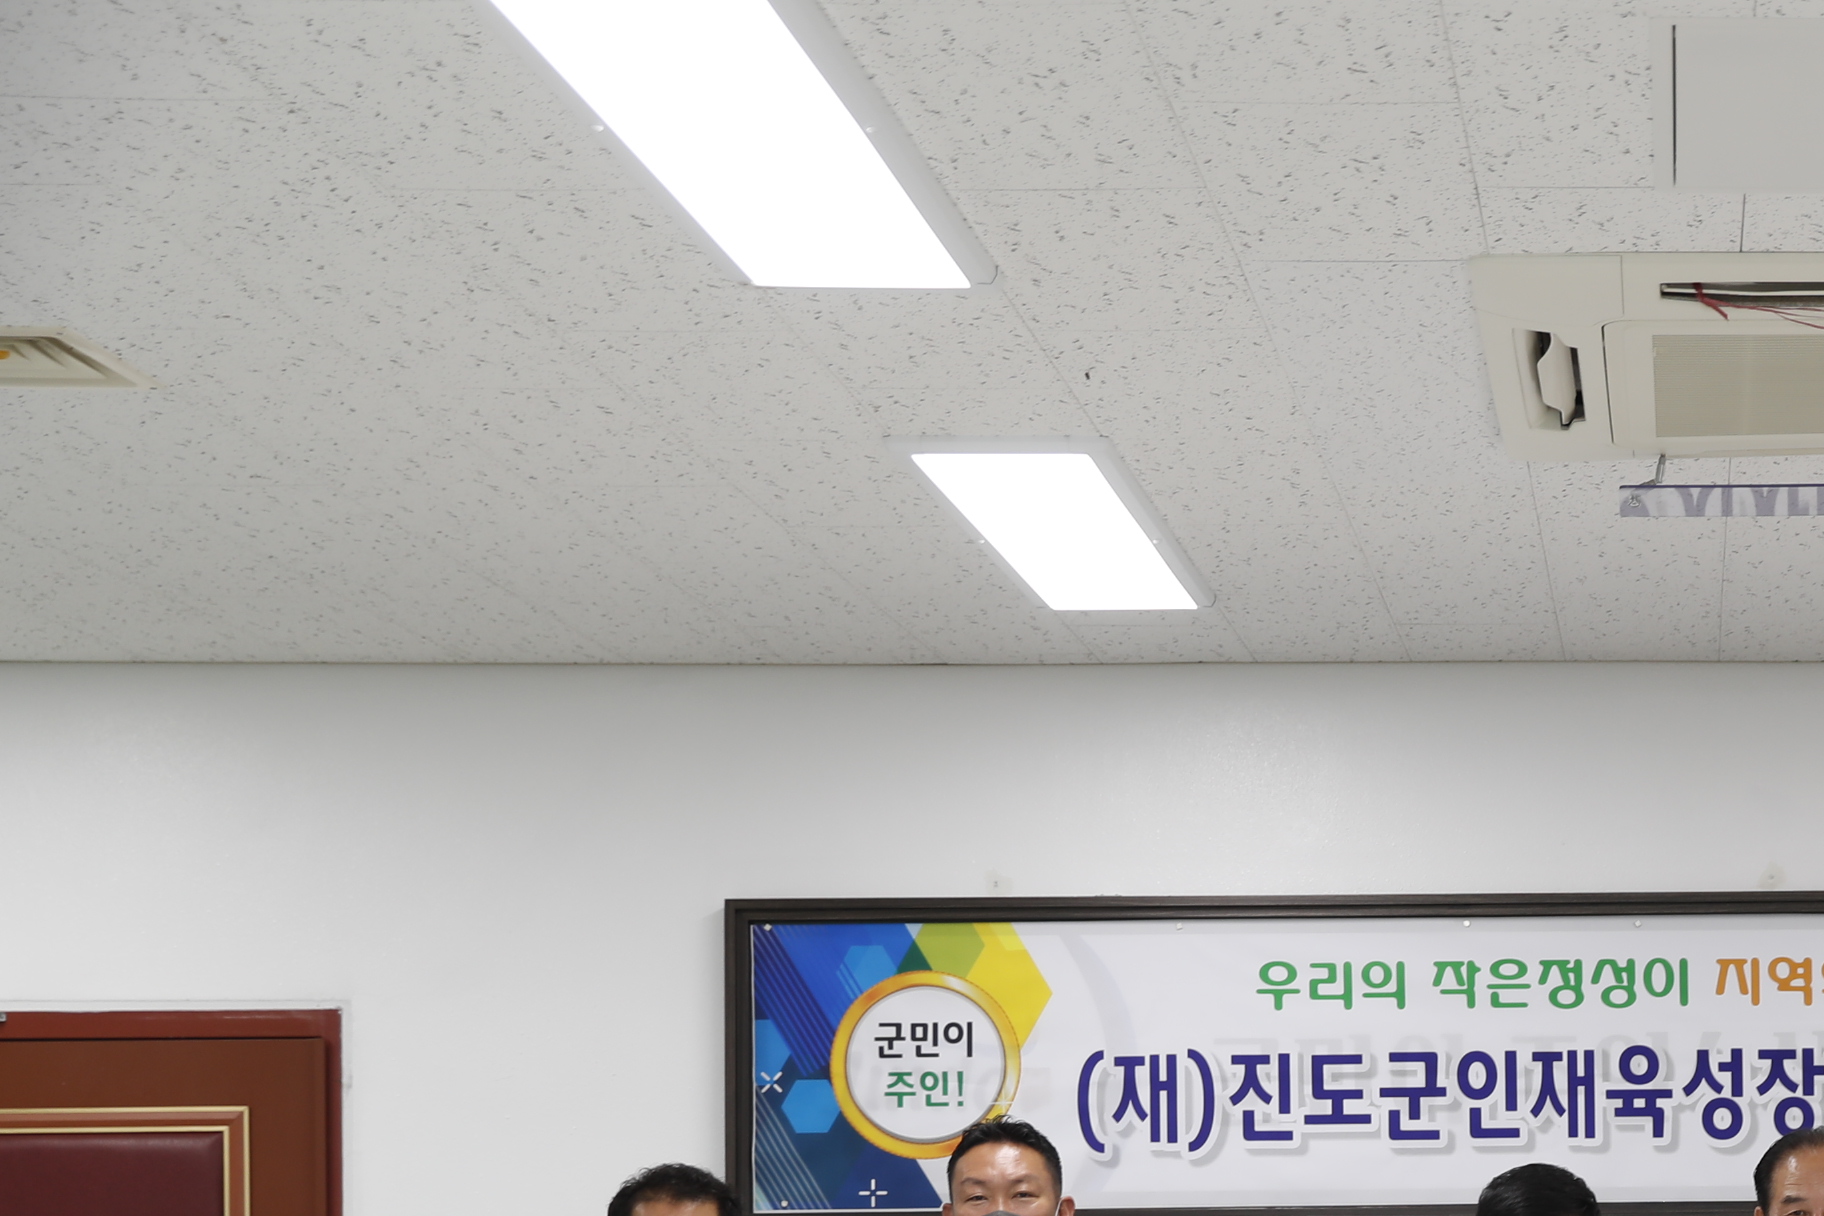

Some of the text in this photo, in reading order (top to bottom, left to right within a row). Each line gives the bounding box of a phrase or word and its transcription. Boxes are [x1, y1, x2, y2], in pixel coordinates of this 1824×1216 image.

[1256, 961, 1405, 1011] 우리의
[1432, 958, 1688, 1009] 작은정성이
[874, 1022, 972, 1058] 군민이
[884, 1071, 963, 1108] 주인!
